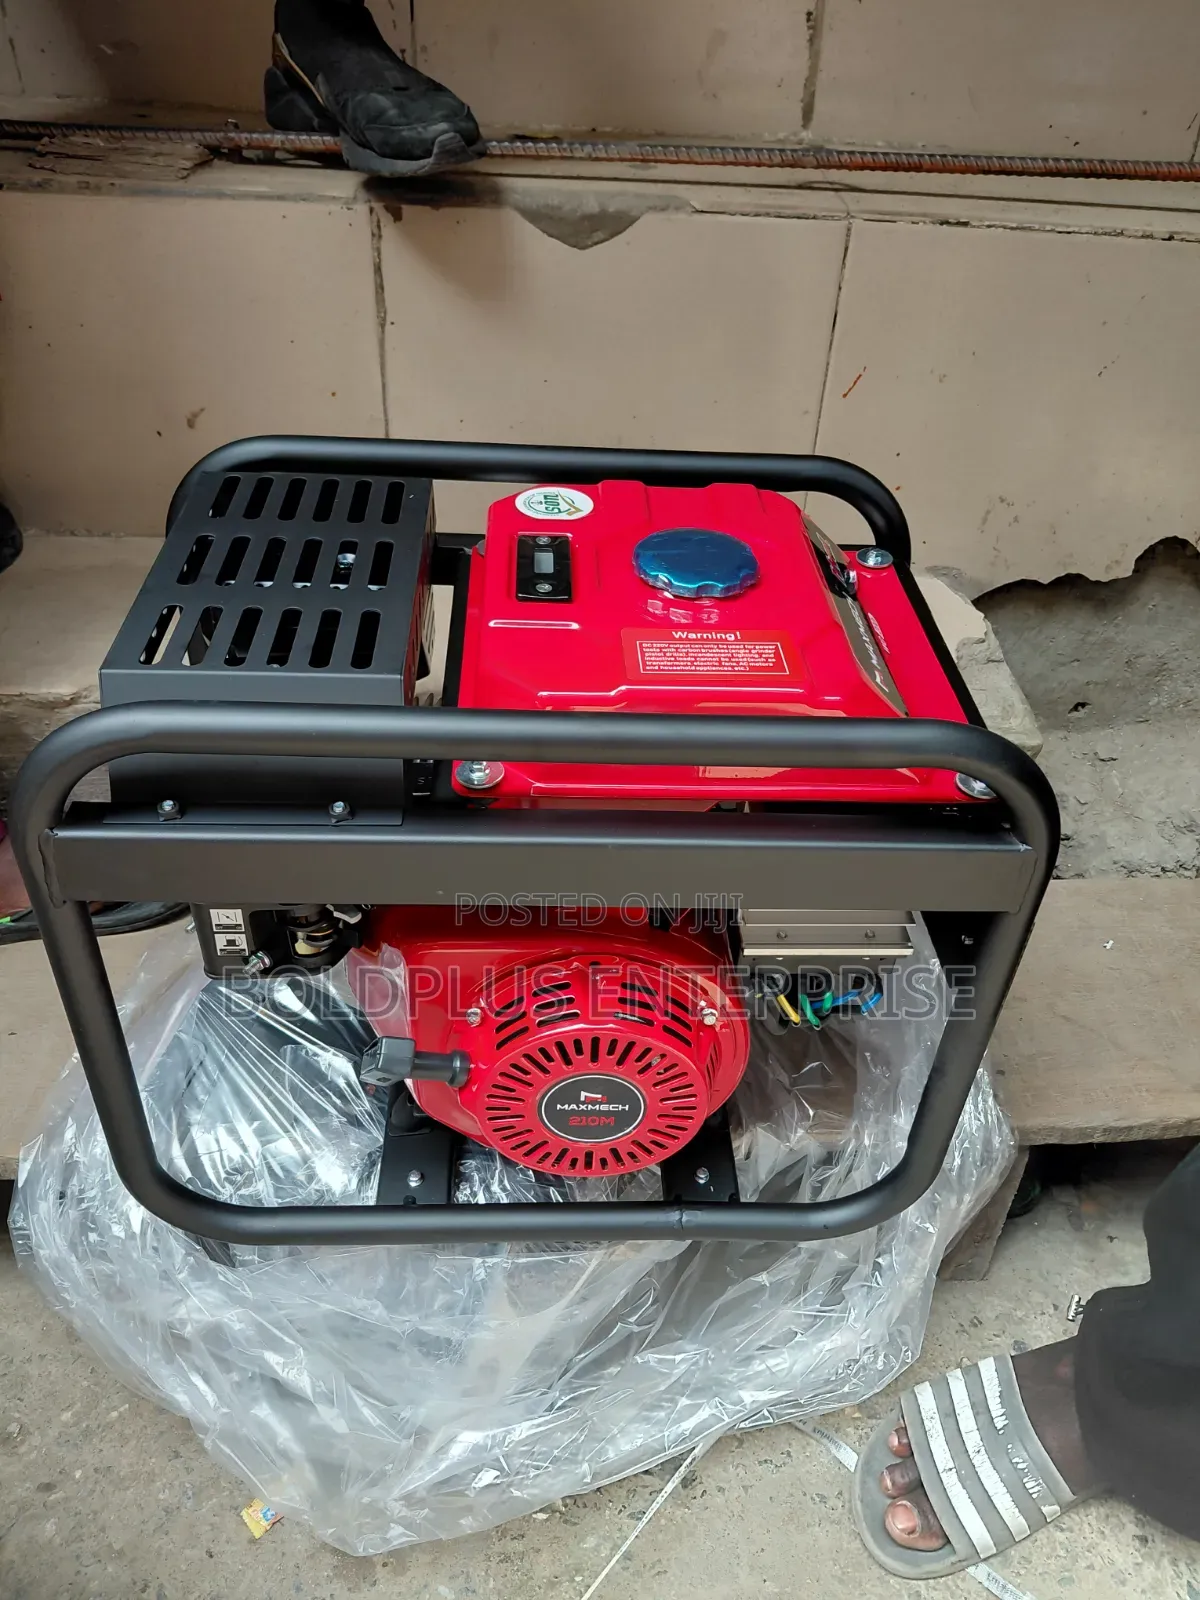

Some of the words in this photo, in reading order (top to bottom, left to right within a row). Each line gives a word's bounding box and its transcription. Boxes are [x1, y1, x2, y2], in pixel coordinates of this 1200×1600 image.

[672, 631, 741, 641] Warning!
[556, 1103, 629, 1111] MAXMECH
[568, 1116, 615, 1126] 210M
